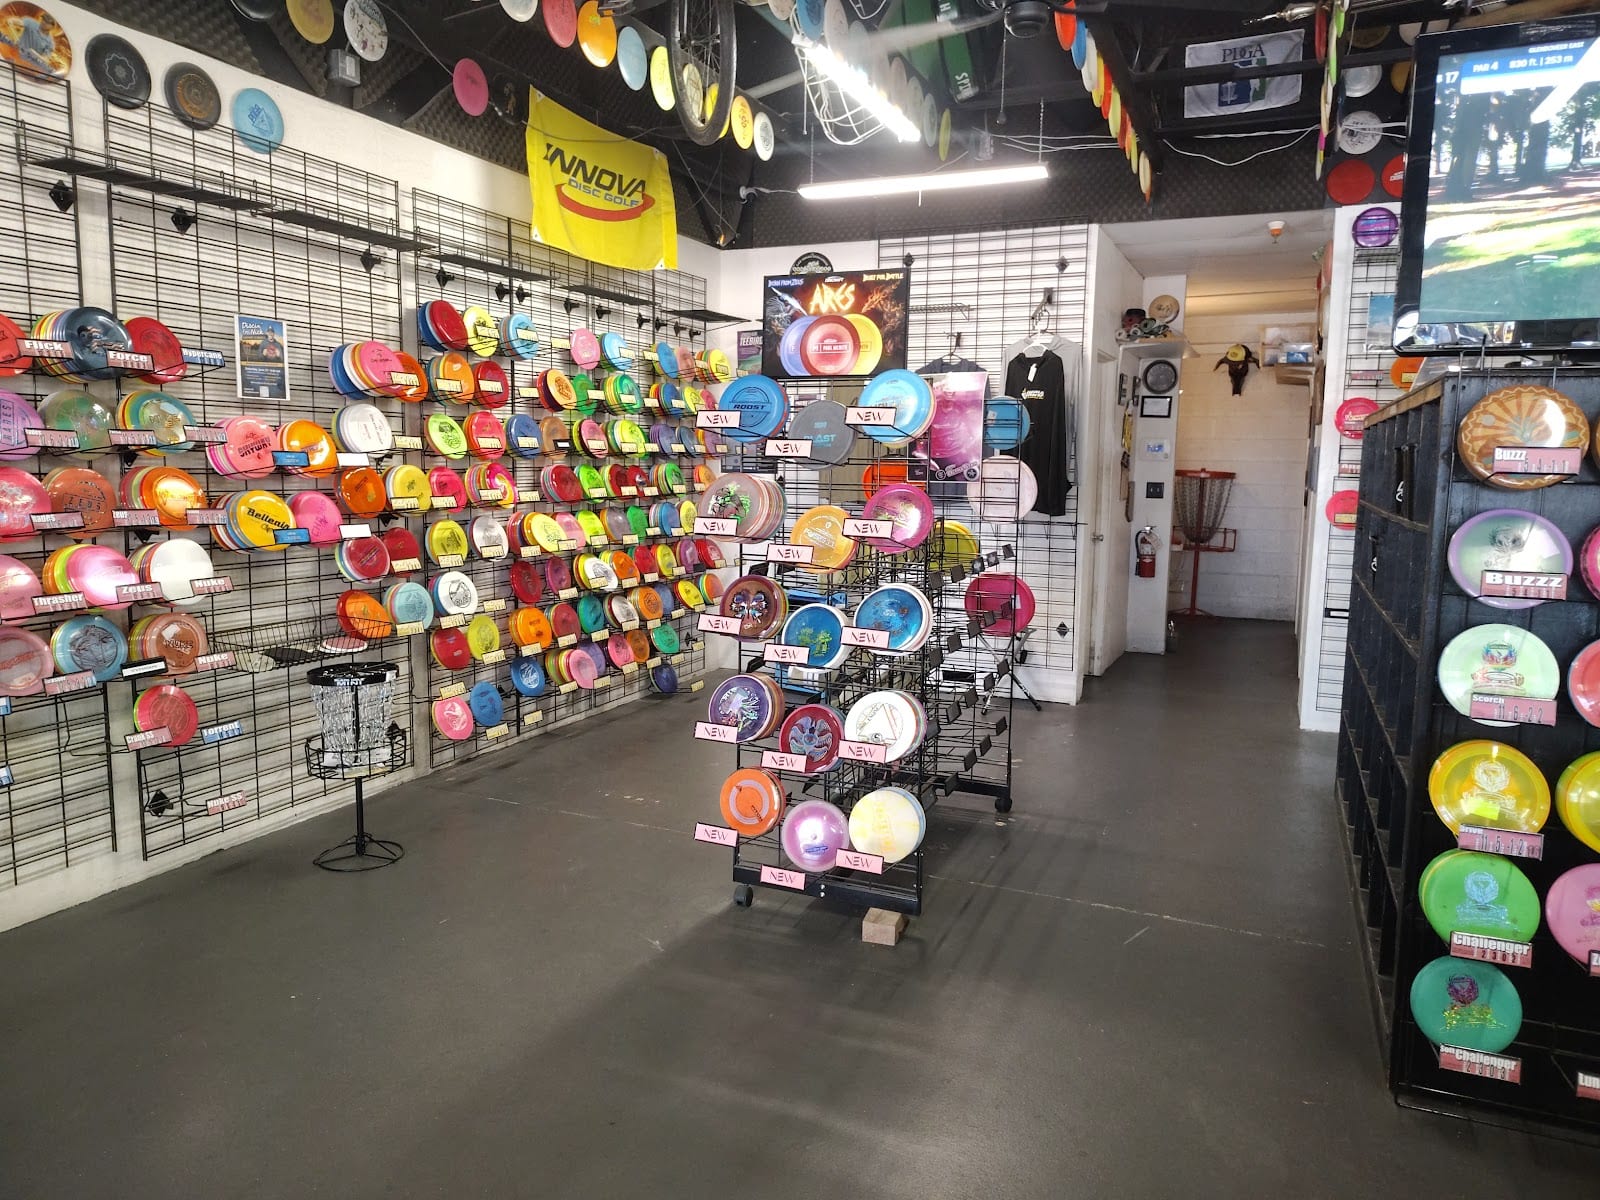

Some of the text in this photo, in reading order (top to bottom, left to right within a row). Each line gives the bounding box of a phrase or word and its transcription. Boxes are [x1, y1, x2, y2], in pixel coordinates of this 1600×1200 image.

[1473, 64, 1489, 72] PAR
[1490, 62, 1498, 70] 4
[1544, 55, 1562, 65] 253
[1445, 71, 1459, 84] 17
[543, 143, 646, 199] INNOVA
[567, 178, 639, 207] DISC GOLF
[810, 282, 855, 314] ARES
[24, 340, 64, 350] Flick
[109, 350, 149, 362] Force
[706, 414, 730, 425] NEW
[856, 411, 884, 423] NEW
[775, 443, 801, 454] NEW
[1494, 447, 1527, 461] Buzzz
[703, 521, 728, 532] NEW
[854, 523, 881, 534] NEW
[777, 548, 802, 559] NEW
[195, 579, 225, 588] Nuke
[1485, 571, 1563, 588] Buzzz
[121, 584, 153, 594] Zeus
[35, 593, 84, 606] Thrasher
[708, 619, 732, 631] NEW
[851, 631, 878, 643] NEW
[198, 653, 229, 664] Nuke
[774, 648, 799, 660] NEW
[1472, 694, 1505, 704] Scorch
[203, 722, 240, 736] Torrent
[703, 727, 729, 738] NEW
[848, 746, 876, 758] NEW
[770, 756, 798, 767] NEW
[703, 829, 729, 841] NEW
[845, 854, 872, 867] NEW
[770, 872, 797, 883] NEW
[1453, 934, 1530, 955] Challenger
[1456, 1049, 1517, 1070] Challenger
